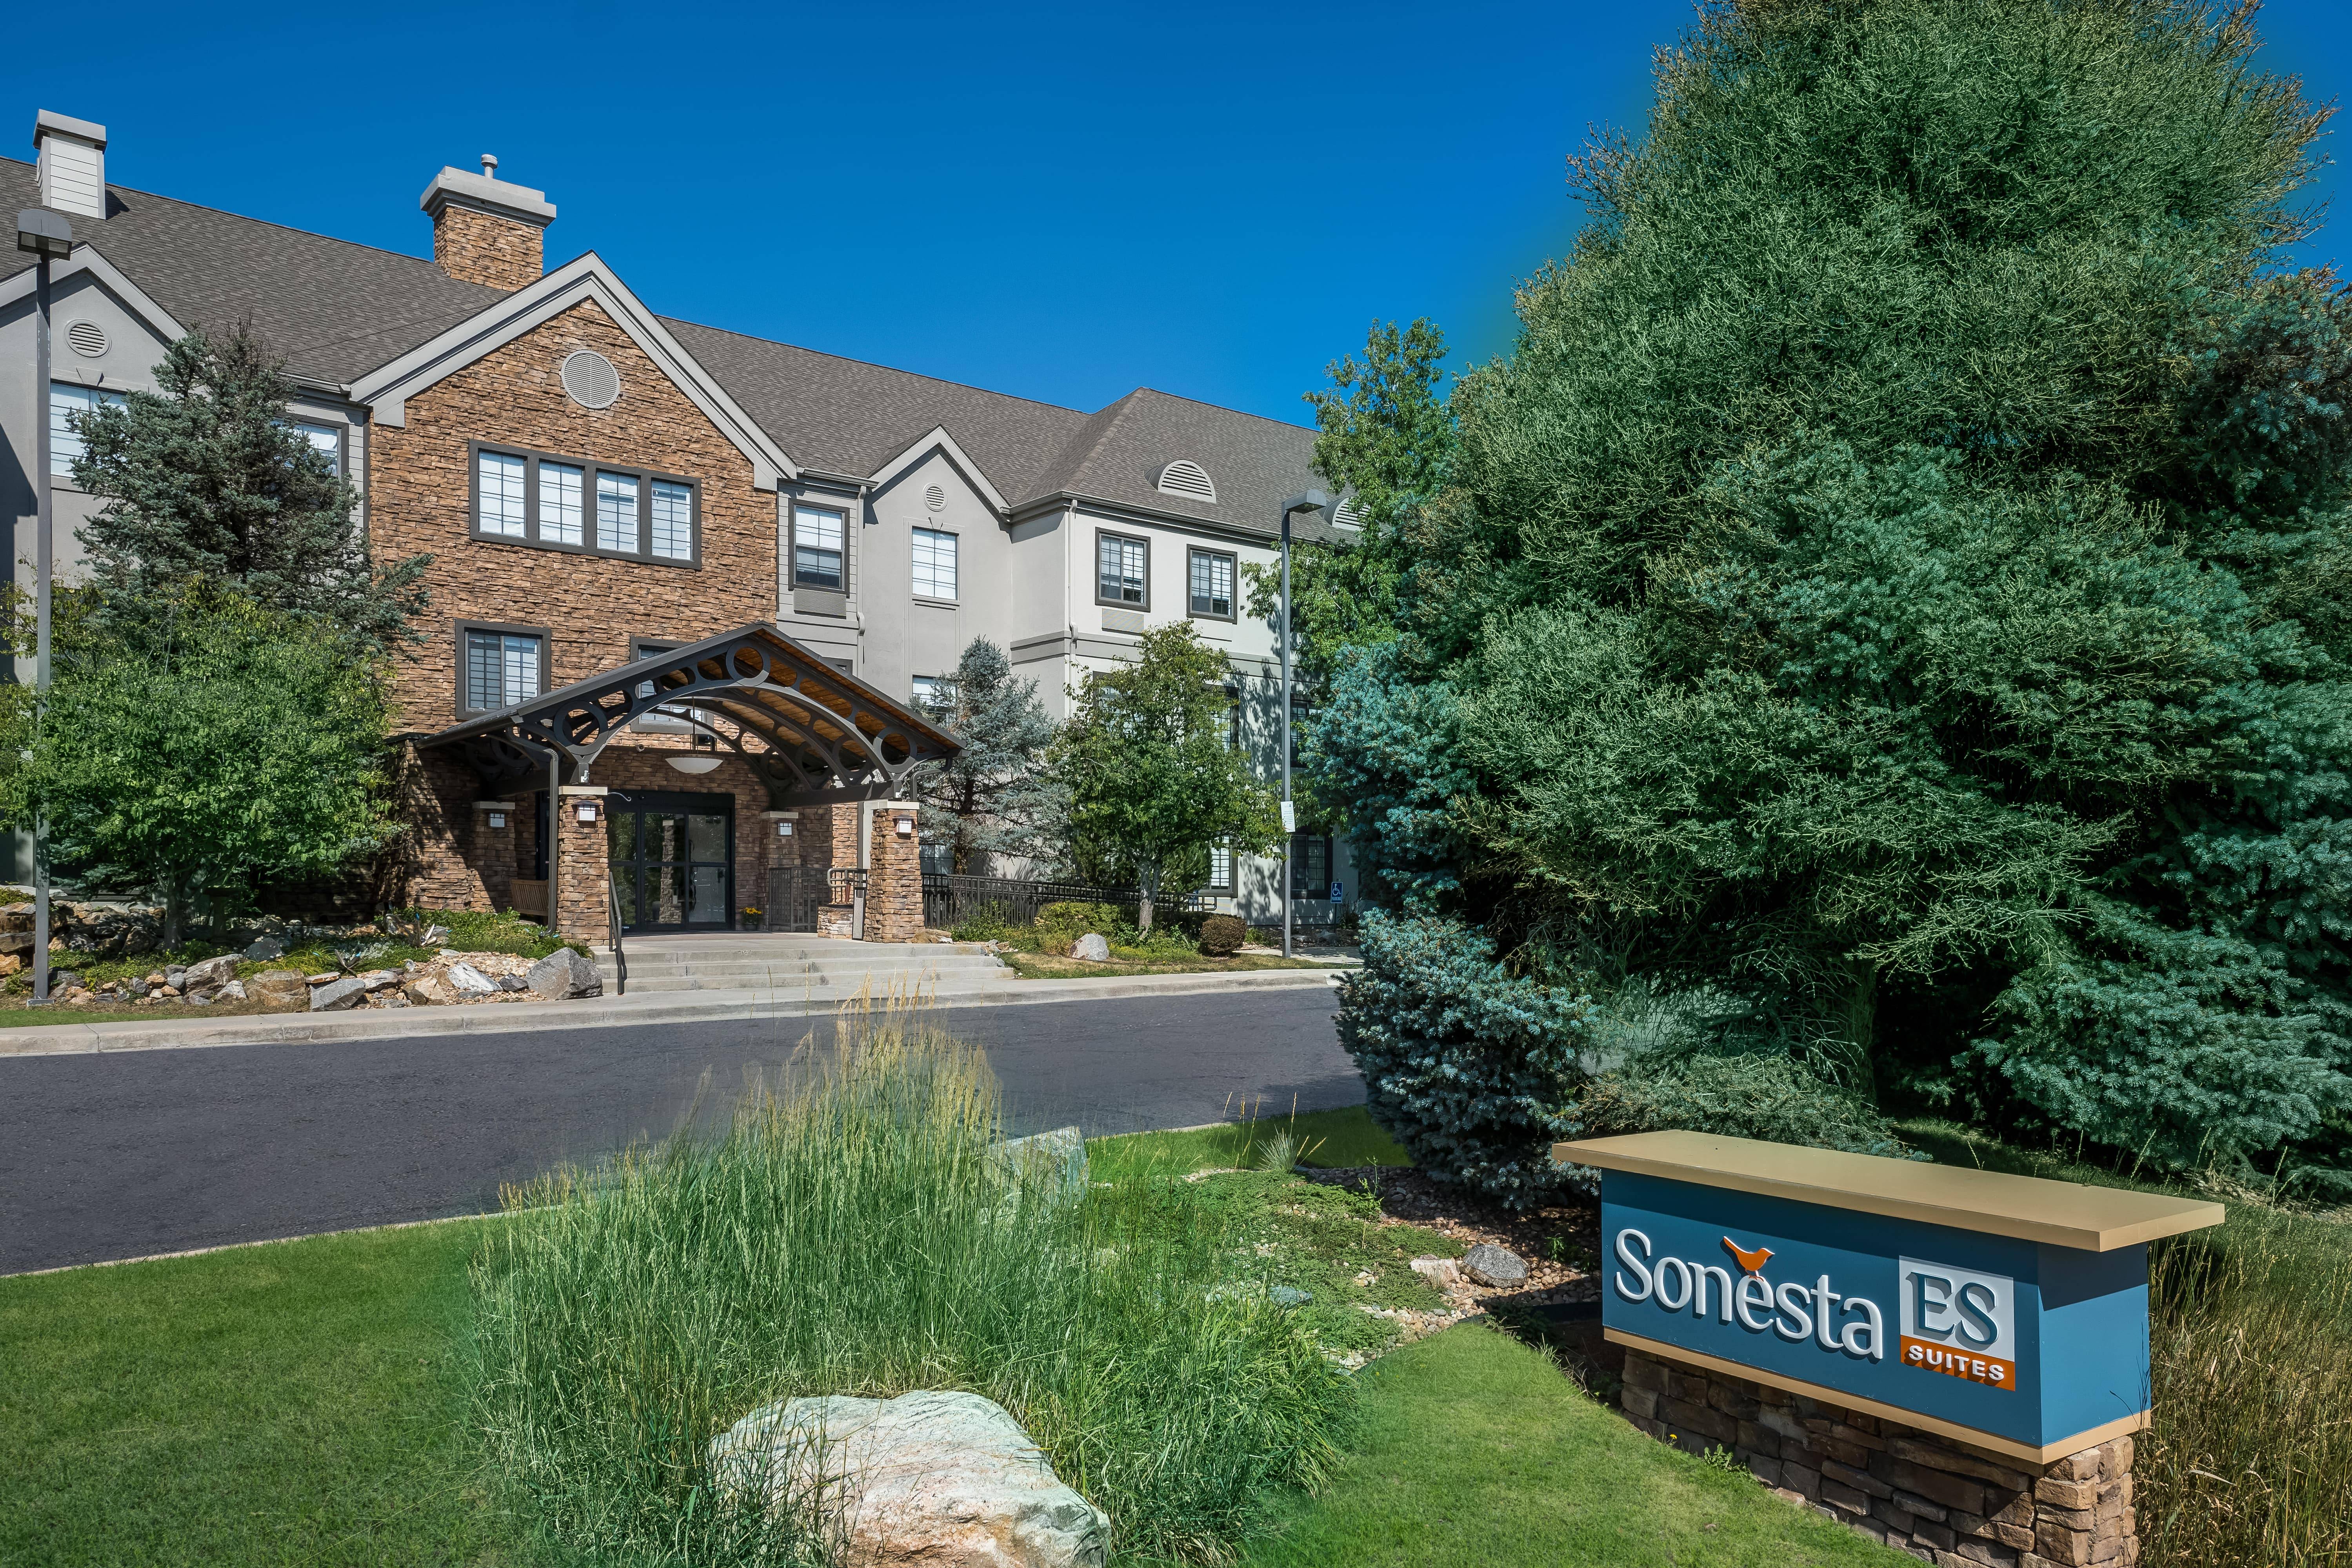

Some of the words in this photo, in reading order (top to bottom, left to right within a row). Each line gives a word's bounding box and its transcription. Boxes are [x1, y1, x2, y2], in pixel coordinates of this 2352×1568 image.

[1616, 1228, 1883, 1359] Sonesta
[1910, 1271, 1999, 1345] ES
[1909, 1345, 2005, 1381] SUITES
